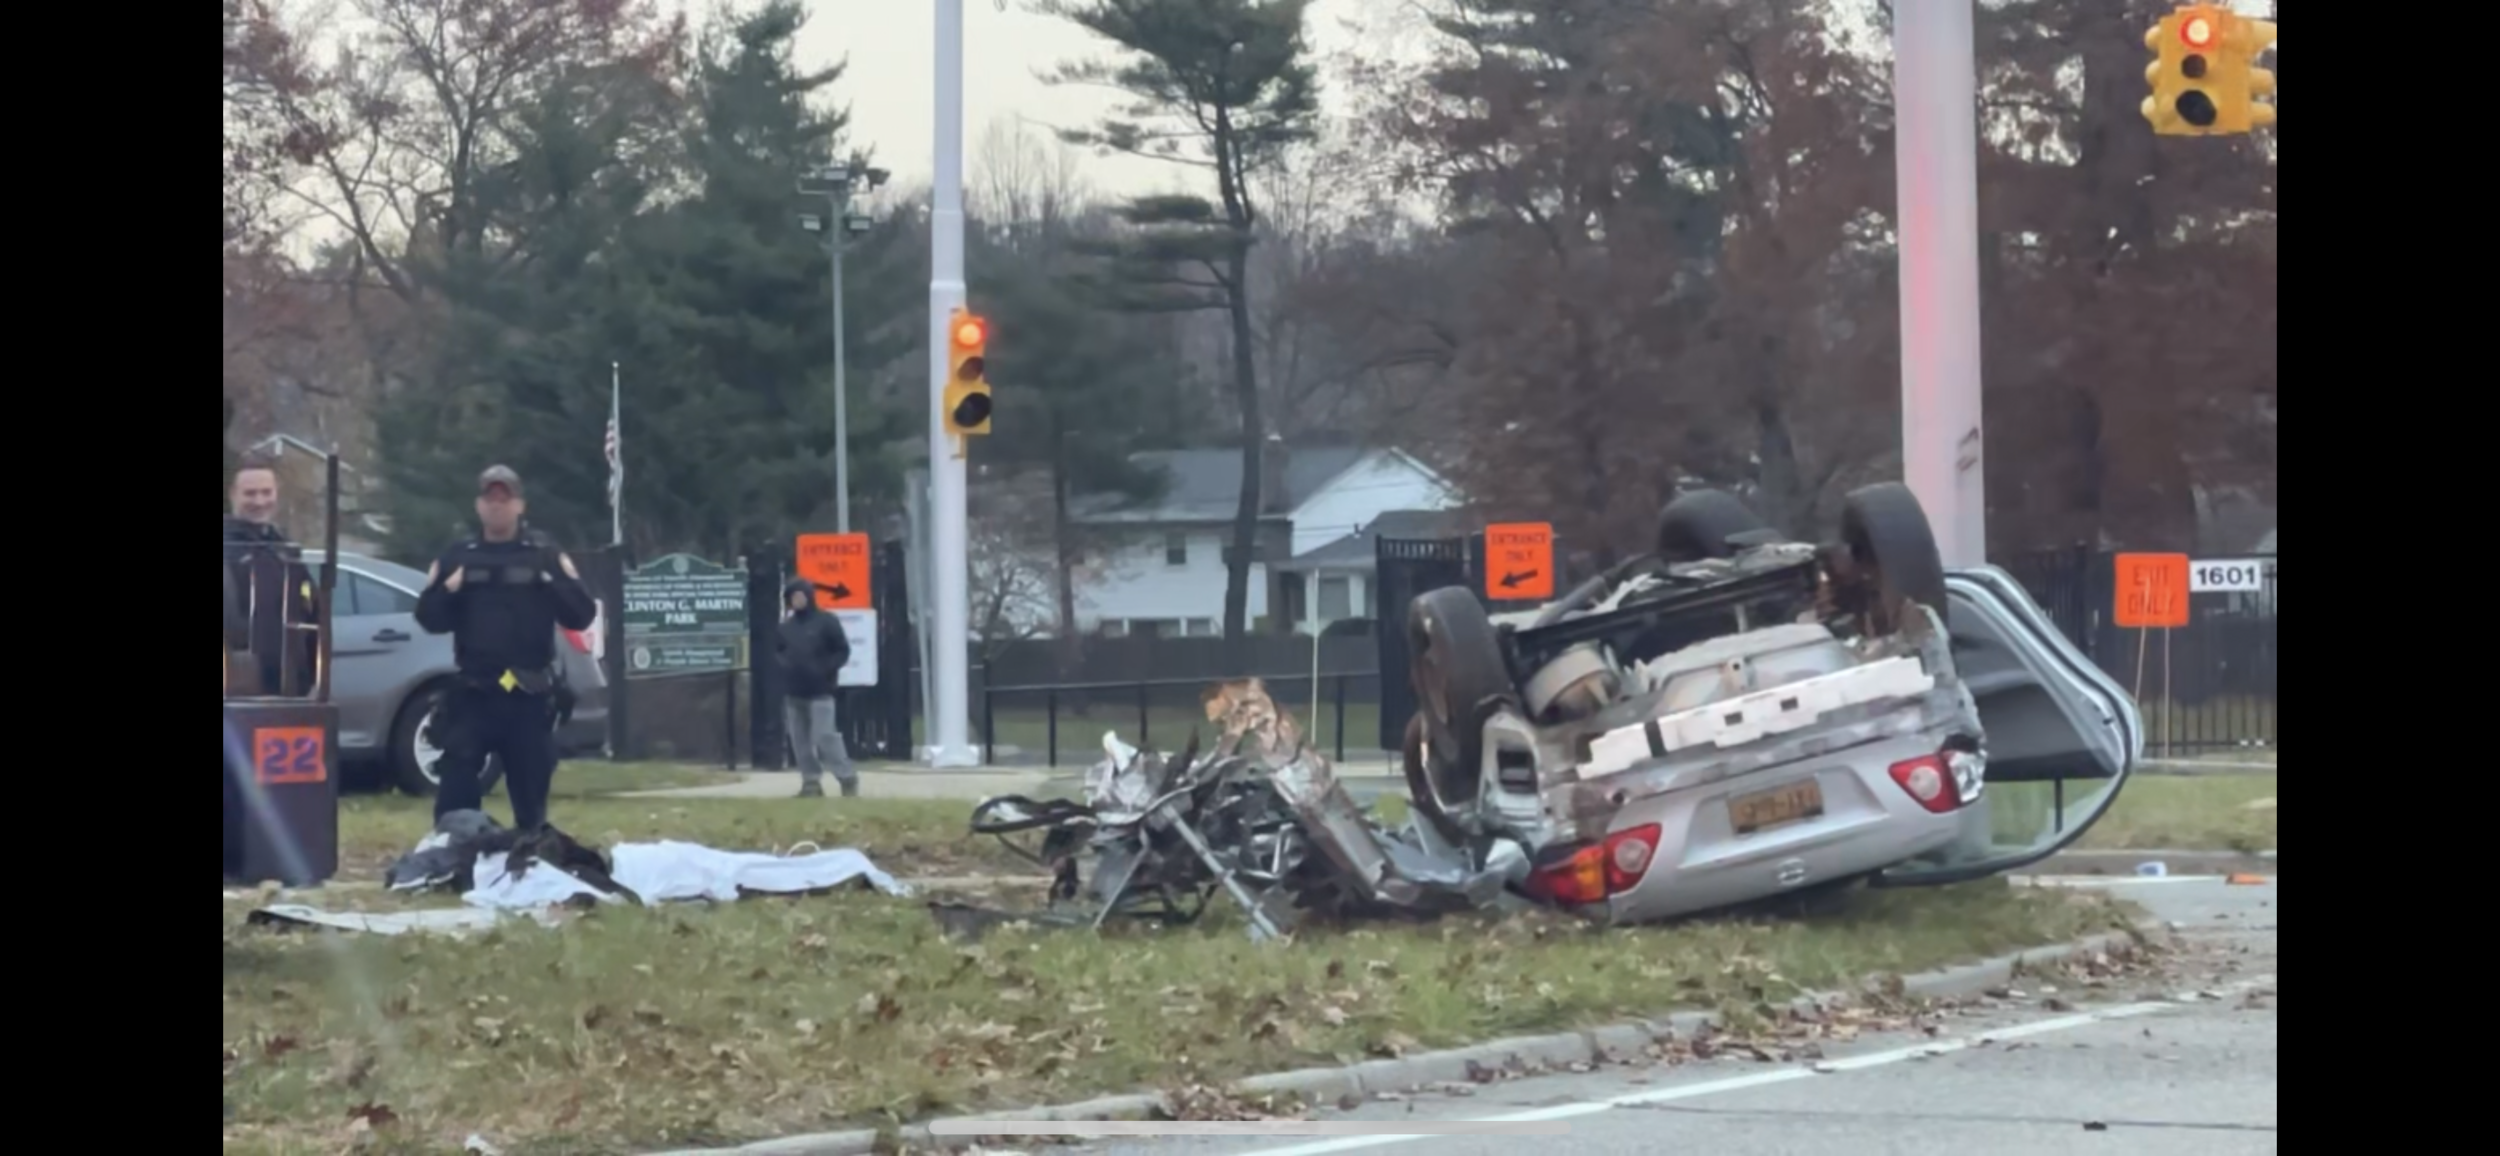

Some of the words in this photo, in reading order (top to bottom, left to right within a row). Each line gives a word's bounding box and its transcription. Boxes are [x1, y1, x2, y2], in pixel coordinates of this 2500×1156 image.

[2197, 566, 2256, 585] 1601
[695, 598, 743, 610] MARTIN
[2127, 593, 2176, 615] ONLY
[665, 612, 697, 624] PARK
[263, 737, 318, 775] 22
